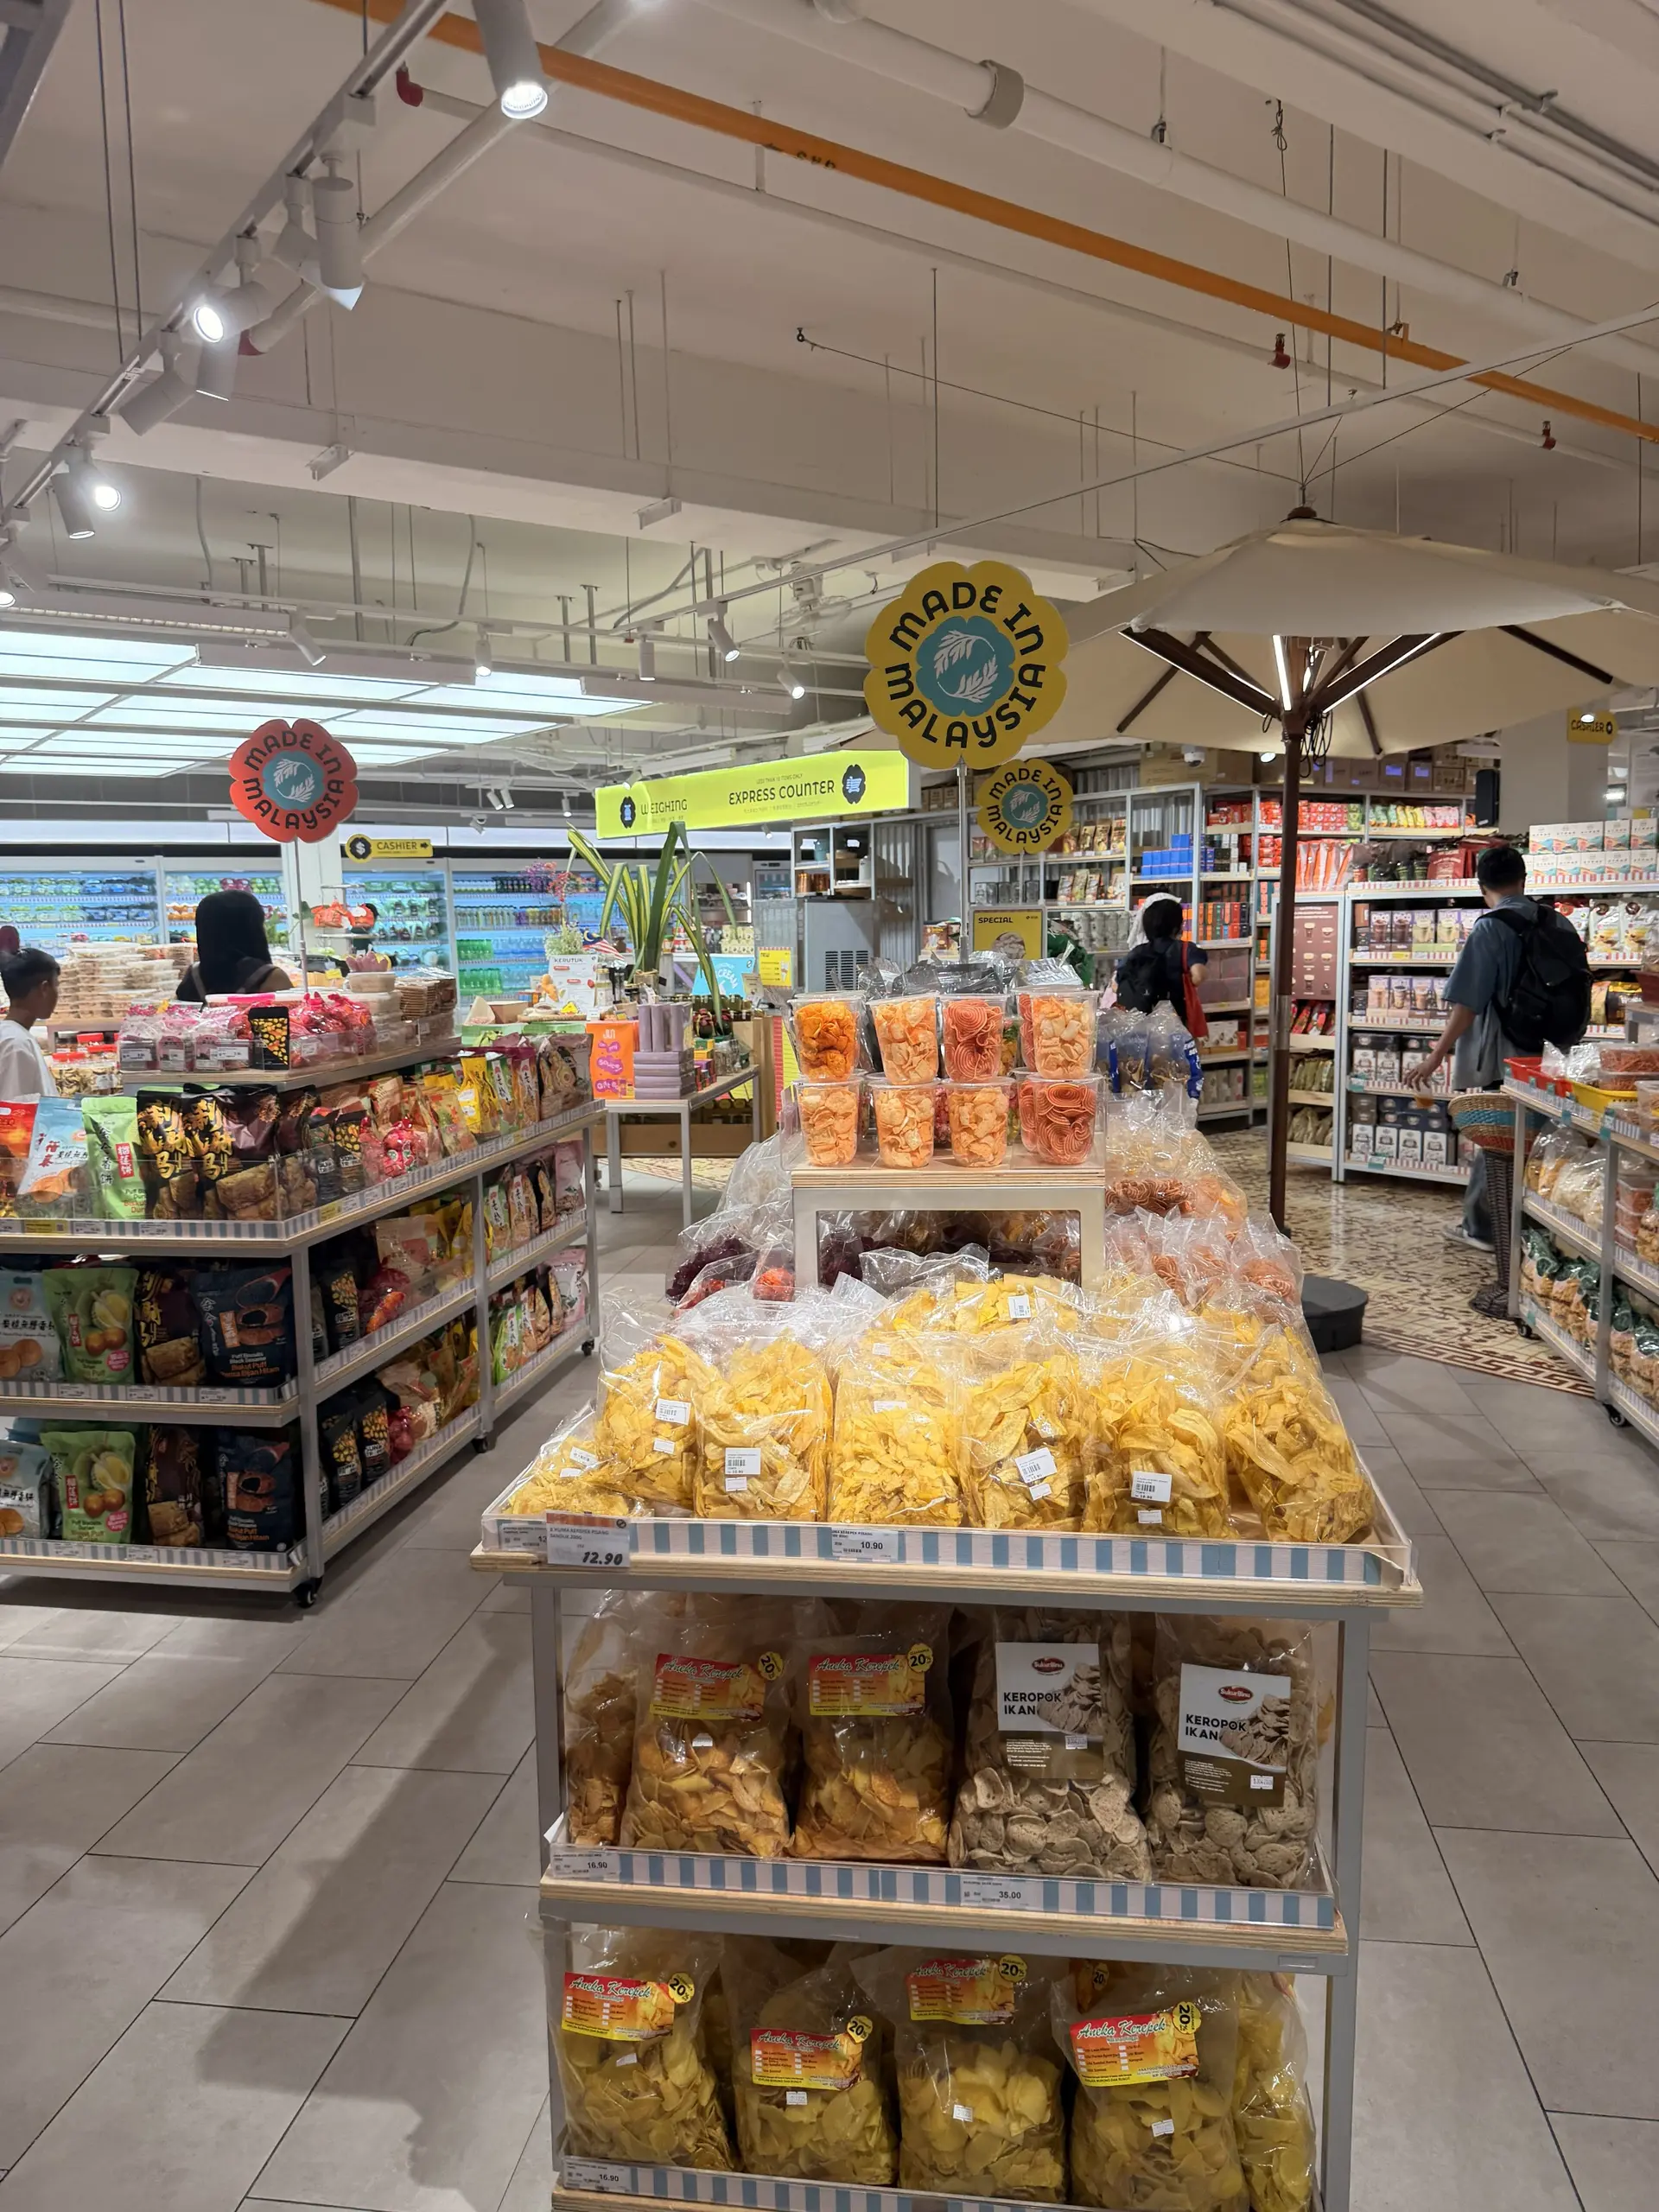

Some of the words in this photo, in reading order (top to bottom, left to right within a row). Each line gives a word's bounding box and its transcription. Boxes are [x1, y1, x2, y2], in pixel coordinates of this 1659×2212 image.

[889, 582, 1003, 652] MADE
[1002, 602, 1045, 656] IN
[885, 662, 1046, 748] MALAYSIA
[245, 730, 314, 771] MADE
[315, 743, 342, 775] IN
[728, 787, 776, 805] EXPRESS
[779, 779, 835, 799] COUNTER
[988, 767, 1042, 800] MADE
[1042, 778, 1062, 801] IN
[243, 778, 344, 830] MALAYSIA
[640, 798, 688, 816] WEIGHING
[986, 804, 1064, 844] MALAYSIA
[377, 842, 417, 850] CASHIER
[861, 1541, 883, 1550] 10.90
[582, 1551, 623, 1566] 12.90
[662, 1658, 698, 1675] Aneka
[700, 1662, 744, 1682] Kerepek
[816, 1657, 853, 1672] Aneka
[855, 1657, 899, 1675] Kerepek
[1003, 1692, 1062, 1703] KEROPOK
[1004, 1705, 1036, 1715] IKAN
[1185, 1713, 1246, 1732] KEROPOK
[1185, 1726, 1218, 1740] IKAN
[999, 1891, 1021, 1899] 35.00
[943, 1962, 986, 1981] Kerepek
[569, 1976, 604, 1993] Aneka
[607, 1980, 652, 1999] Kerepek
[1077, 2022, 1116, 2039] Aneka
[1118, 2018, 1166, 2037] Kerepek
[757, 2031, 793, 2044] Aneka
[795, 2034, 841, 2050] Kerepek
